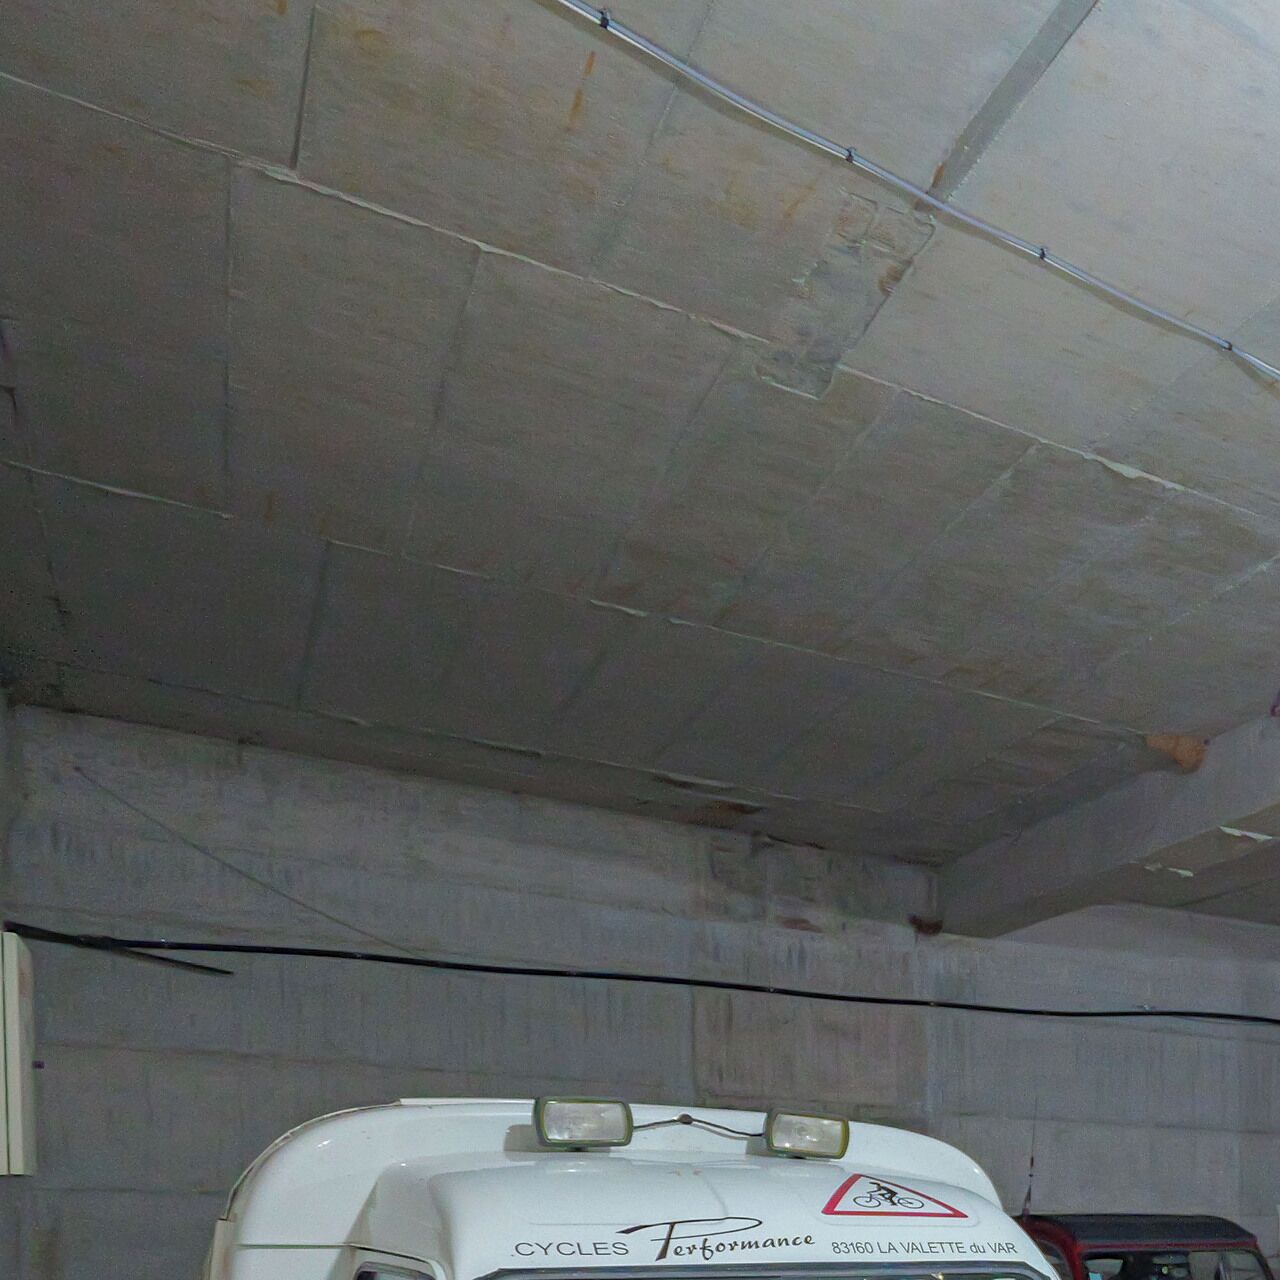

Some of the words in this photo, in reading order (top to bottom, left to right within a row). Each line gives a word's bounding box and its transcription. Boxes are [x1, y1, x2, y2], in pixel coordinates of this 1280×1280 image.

[514, 1242, 630, 1256] CYCLES
[616, 1216, 816, 1262] Performance
[832, 1241, 875, 1254] 83160
[877, 1242, 898, 1254] LA
[900, 1242, 963, 1255] VALETTE
[969, 1242, 986, 1254] du
[988, 1243, 1018, 1254] VAR
